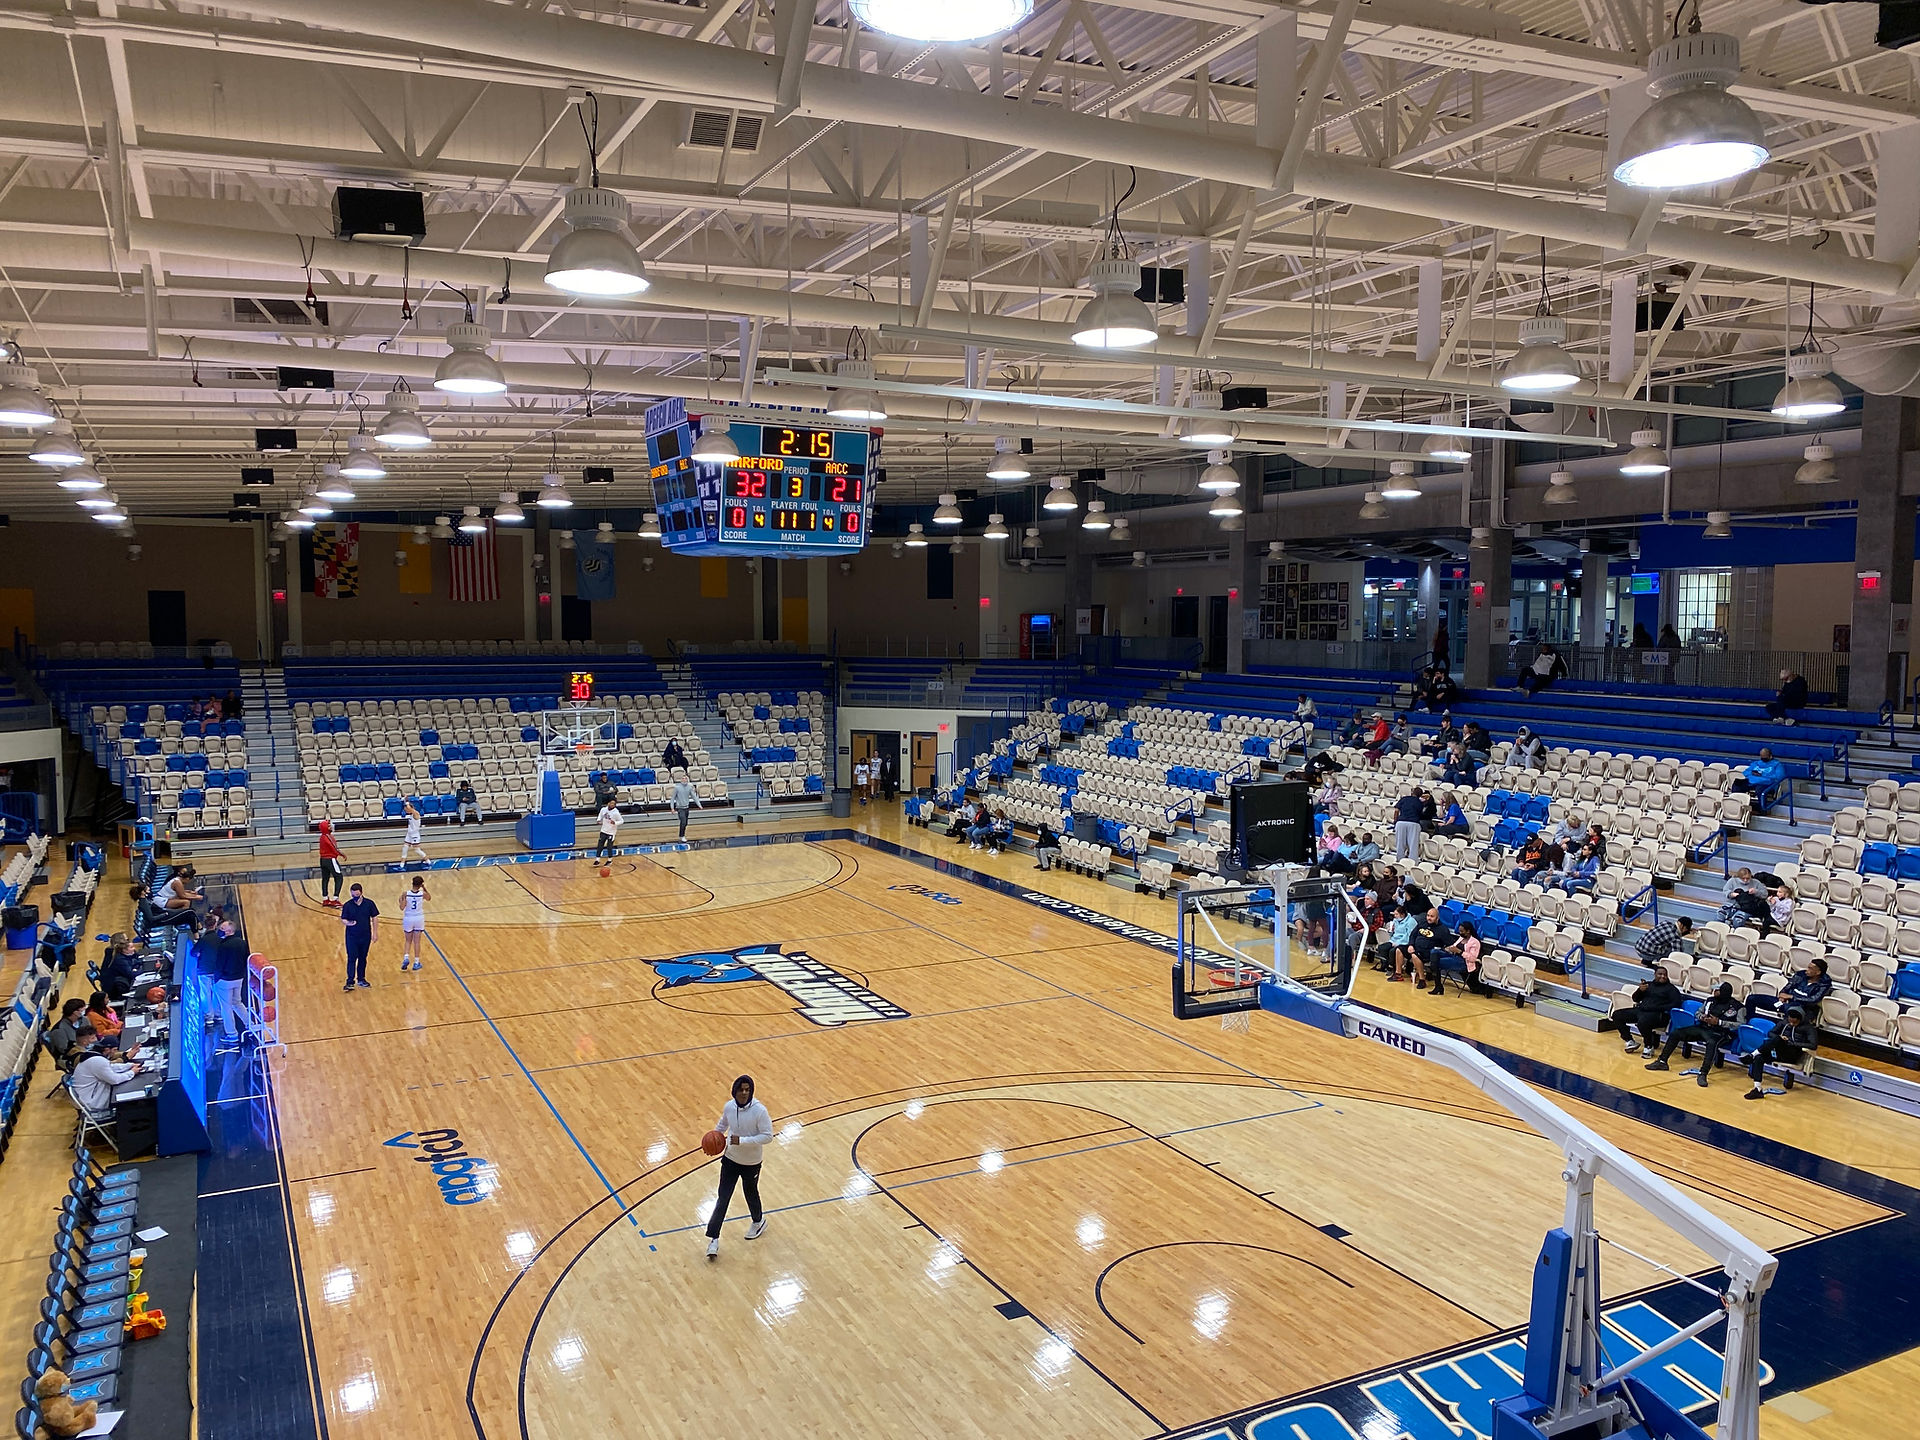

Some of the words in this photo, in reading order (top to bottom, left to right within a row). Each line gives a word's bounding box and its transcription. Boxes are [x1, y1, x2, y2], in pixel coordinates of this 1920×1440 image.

[780, 429, 830, 457] 2:15
[783, 466, 809, 475] PERIOD
[825, 462, 849, 475] AACC
[736, 471, 767, 497] 32
[792, 477, 802, 497] 3
[832, 477, 861, 502] 21
[724, 499, 748, 507] FOULS
[771, 501, 798, 510] PLAYER
[801, 503, 819, 511] FOUL
[840, 504, 862, 513] FOULS
[733, 507, 744, 528] 0
[755, 514, 765, 527] 4
[824, 517, 833, 530] 4
[847, 513, 859, 533] 0
[724, 531, 748, 540] SCORE
[781, 533, 806, 542] MATCH
[838, 535, 860, 544] SCORE
[1863, 577, 1877, 588] EXIT
[571, 674, 593, 684] 2:15
[571, 683, 590, 699] 30
[411, 900, 418, 910] 3
[735, 953, 887, 1027] HARFORD
[1358, 1020, 1426, 1057] GARED
[413, 1128, 500, 1206] apgfcu
